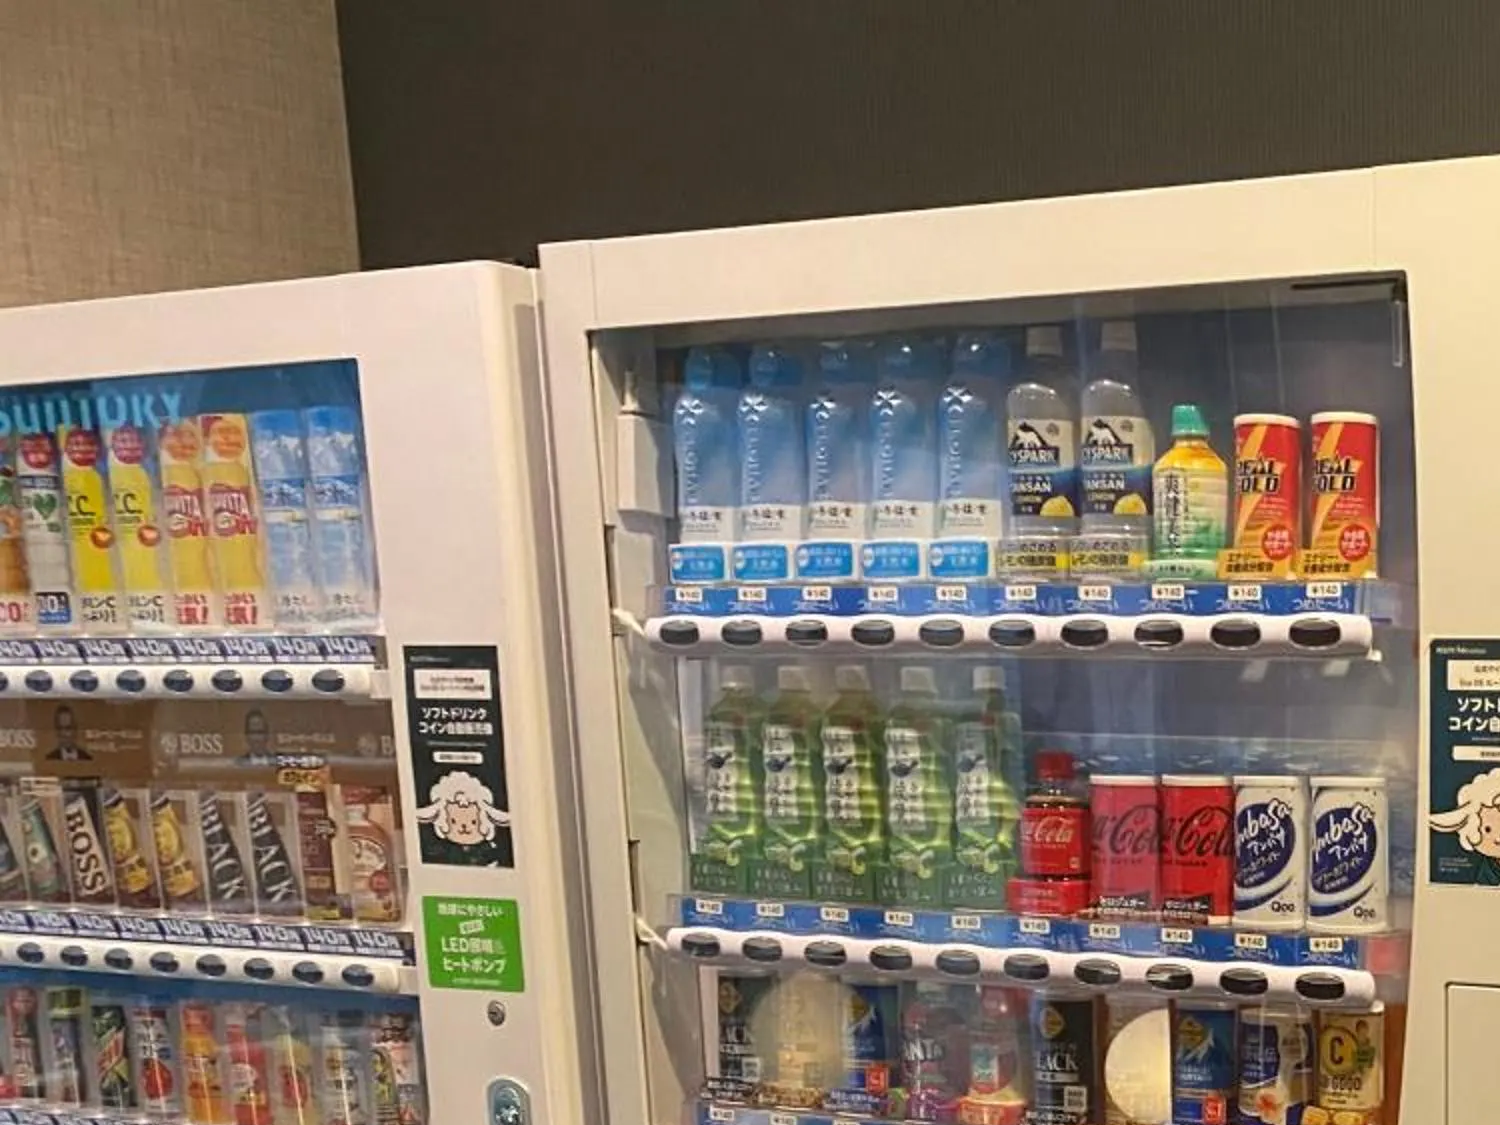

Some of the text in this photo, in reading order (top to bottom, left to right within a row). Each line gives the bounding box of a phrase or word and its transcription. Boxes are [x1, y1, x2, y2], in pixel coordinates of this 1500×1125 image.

[1239, 476, 1280, 494] OLD
[1315, 476, 1356, 494] OLD
[0, 638, 33, 657] 40円
[421, 707, 487, 720] ソフトドリンク
[180, 733, 223, 755] BOSS
[65, 808, 107, 897] BOSS
[1271, 901, 1297, 914] Qoo
[1353, 907, 1377, 920] Qoo
[442, 957, 508, 974] ヒートポンプ
